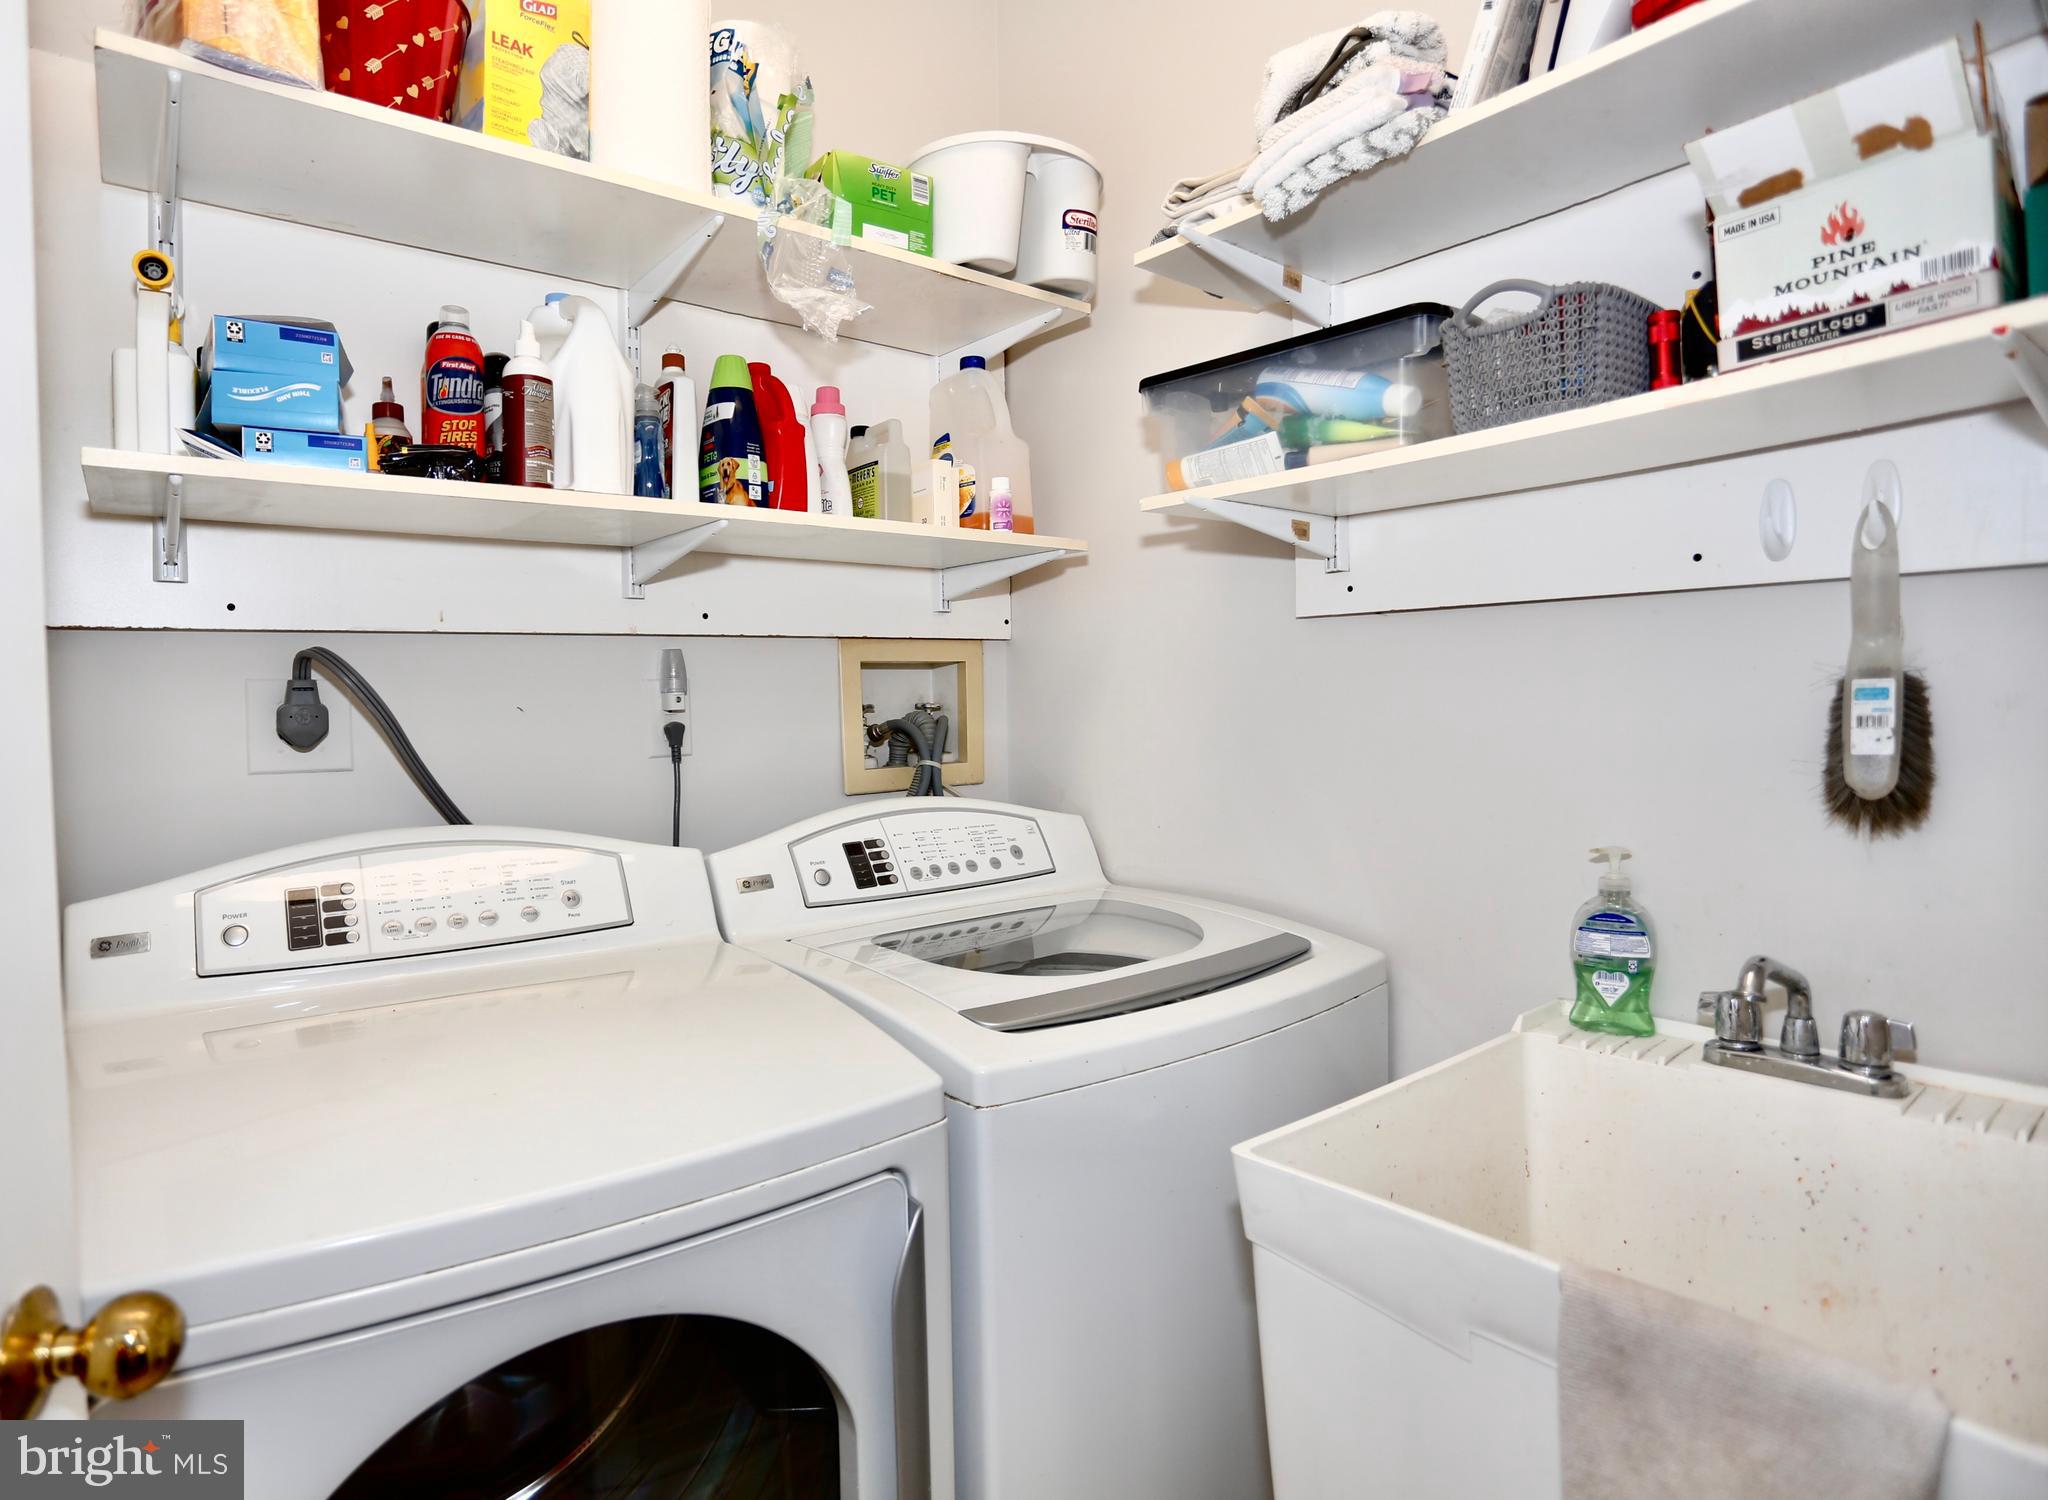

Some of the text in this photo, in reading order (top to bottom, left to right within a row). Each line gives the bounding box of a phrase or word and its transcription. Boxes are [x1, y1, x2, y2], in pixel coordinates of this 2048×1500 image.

[522, 0, 556, 16] GLAD
[519, 12, 556, 33] ForceFlex
[491, 31, 534, 59] LEAK
[869, 163, 900, 179] Swiffer
[871, 186, 897, 203] PET
[1723, 212, 1776, 237] MADE IN USA
[1811, 240, 1877, 270] PINE
[1774, 244, 1924, 297] MOUNTAIN
[1895, 286, 1972, 312] LIGHTS WOOD
[1918, 300, 1949, 315] FAST!
[1751, 312, 1867, 350] StarterLogg
[1776, 330, 1840, 353] FIRESTARTER
[458, 362, 476, 371] Alert
[232, 386, 269, 394] FLEXIBLE
[431, 373, 484, 402] Tundra
[276, 394, 291, 402] AND
[441, 419, 478, 432] STOP
[439, 431, 478, 444] FIRES
[222, 912, 248, 921] POWER
